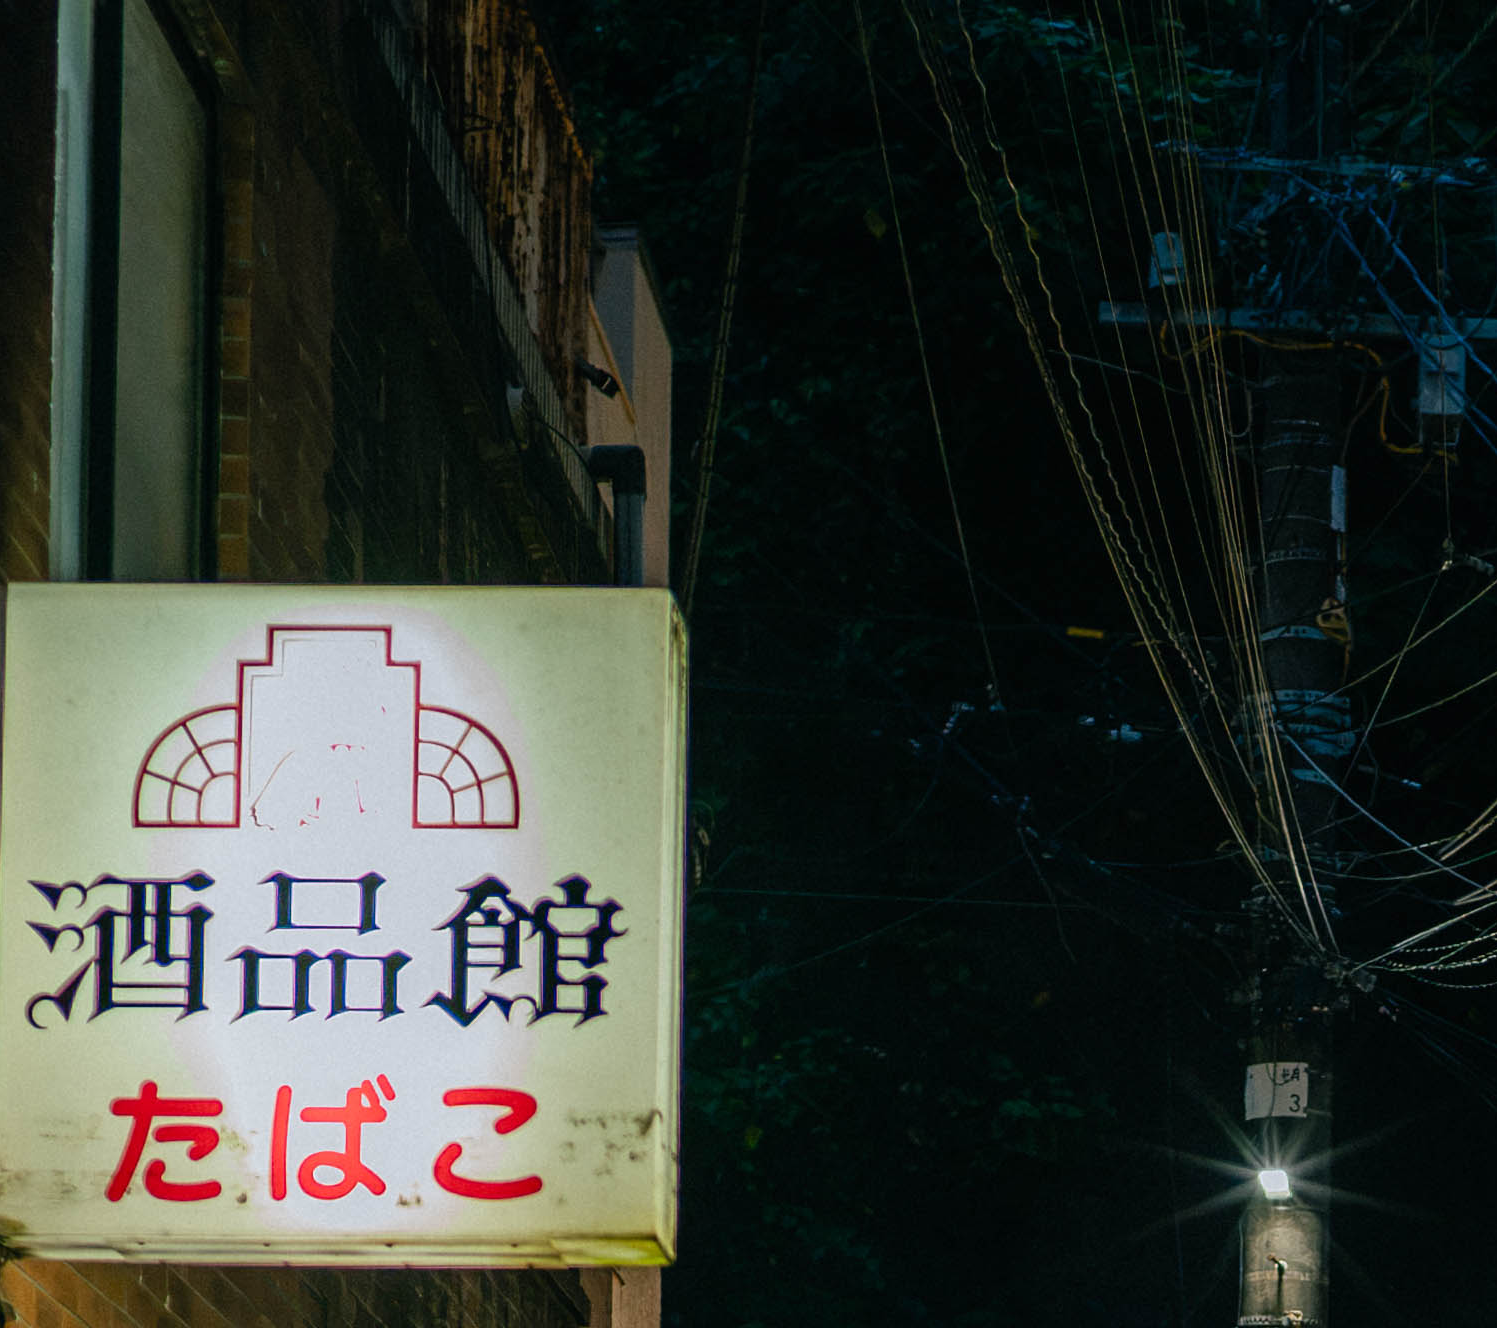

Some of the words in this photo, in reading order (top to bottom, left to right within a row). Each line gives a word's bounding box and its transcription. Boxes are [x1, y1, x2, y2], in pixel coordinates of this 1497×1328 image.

[26, 871, 630, 1029] 酒品館
[104, 1074, 543, 1202] たばこ
